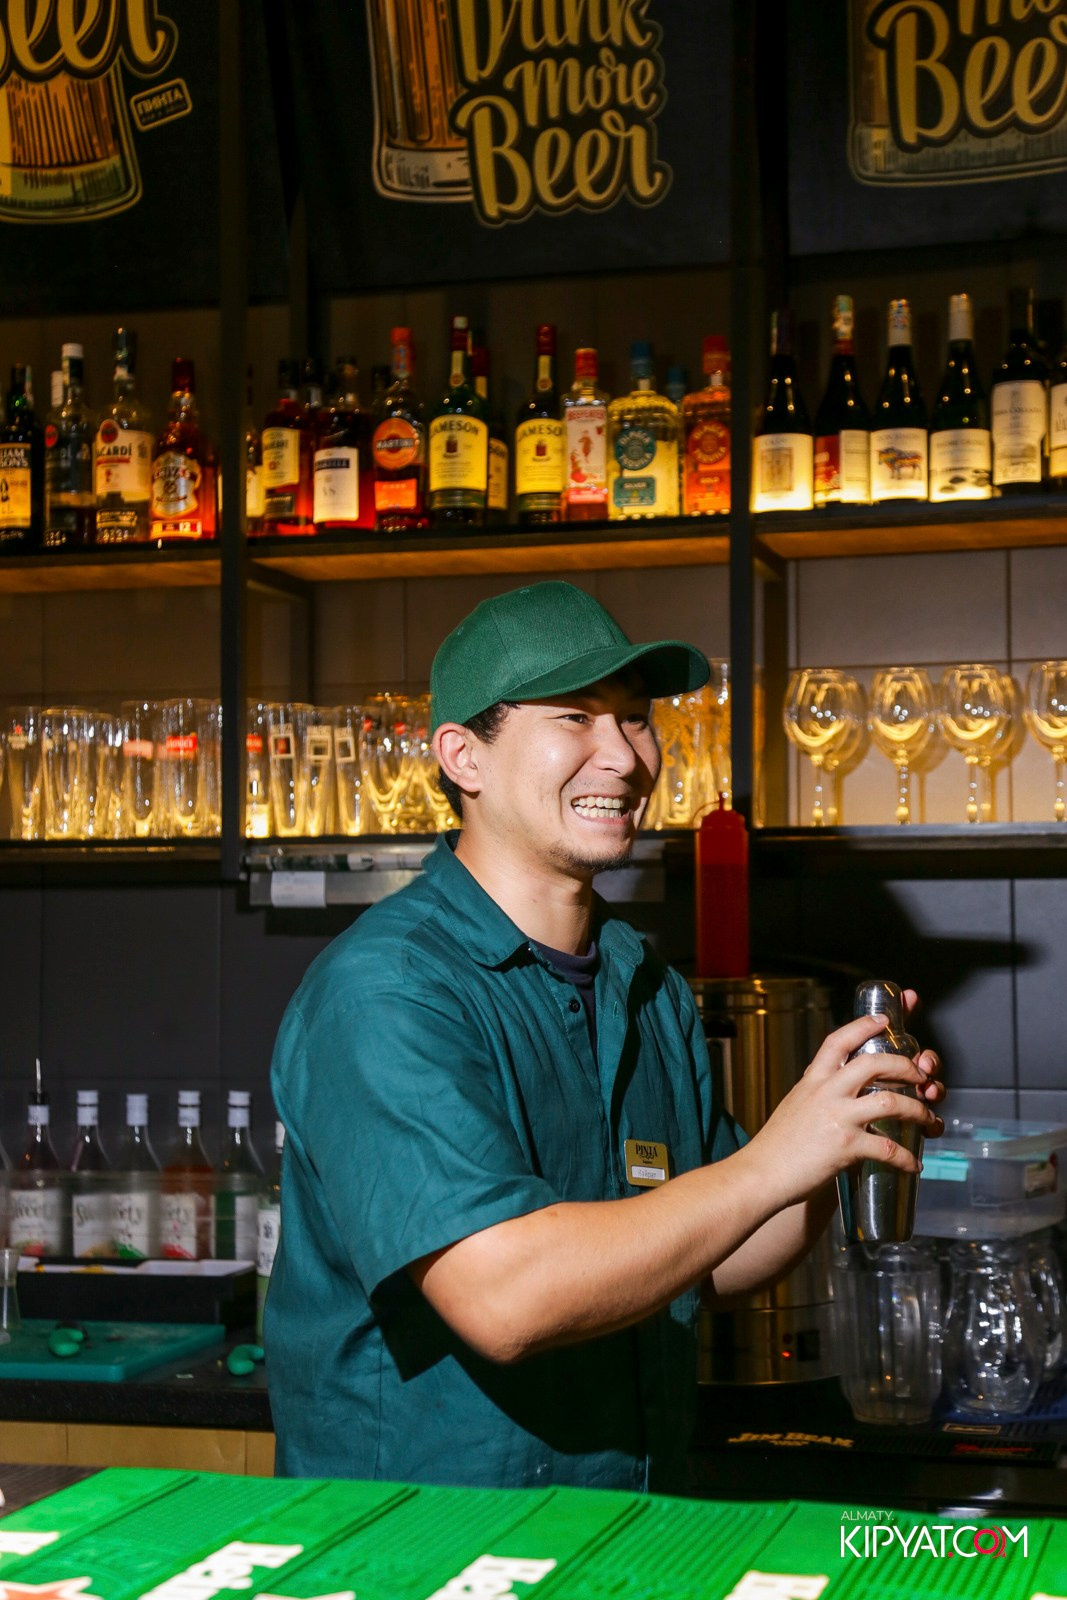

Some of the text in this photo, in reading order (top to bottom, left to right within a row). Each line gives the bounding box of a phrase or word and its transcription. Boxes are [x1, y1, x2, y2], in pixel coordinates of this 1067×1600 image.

[0, 0, 167, 72] eer
[503, 47, 656, 127] more
[875, 0, 1067, 145] Bee
[455, 95, 662, 219] Beer
[430, 420, 480, 438] JAMESON
[518, 424, 563, 442] JAMESO
[635, 1142, 658, 1157] PINTA
